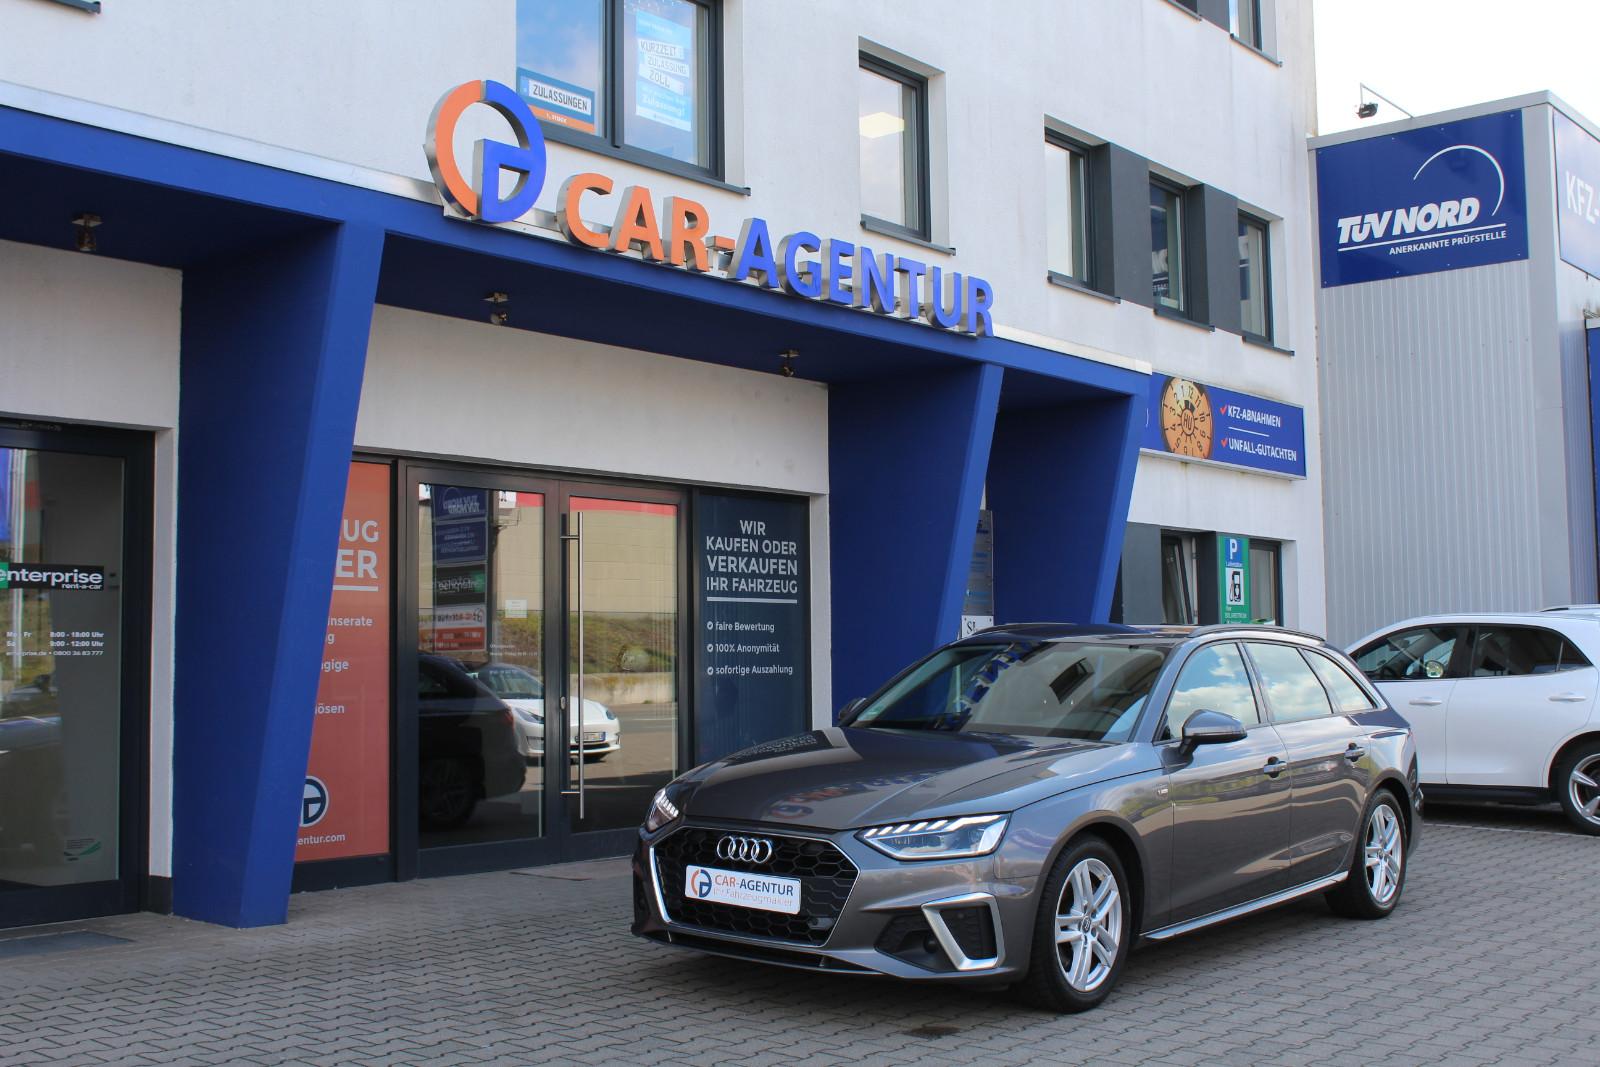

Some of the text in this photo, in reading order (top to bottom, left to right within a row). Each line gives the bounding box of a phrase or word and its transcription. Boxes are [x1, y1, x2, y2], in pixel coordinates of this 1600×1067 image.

[640, 41, 676, 56] KURZZEIT
[648, 56, 687, 74] ZULASSUNG
[649, 70, 671, 88] ZOLL
[532, 84, 588, 111] ZULASSUNGEN
[1565, 170, 1600, 225] KFZ-
[1392, 197, 1480, 235] NORD
[1388, 229, 1507, 256] ANERKANNTE PRÜFSTELLE
[557, 171, 994, 338] CAR-AGENTUR
[1227, 405, 1282, 428] KFZ-ABNAHMEN
[1228, 437, 1297, 462] UNFALL-GUTACHTEN
[343, 519, 379, 543] UG
[739, 519, 766, 536] WIR
[706, 536, 798, 556] KAUFEN ODER
[1229, 538, 1238, 560] P
[336, 548, 378, 580] ER
[706, 554, 798, 576] VERKAUFEN
[0, 568, 103, 587] enterprise
[61, 582, 103, 590] rent-a-car
[706, 576, 798, 594] IHR FAHRZEUG
[715, 621, 775, 634] faire Bewertung
[715, 642, 780, 655] 100% Anonymität
[321, 659, 350, 672] gige
[715, 664, 793, 676] sofortige Auszahlung
[296, 834, 346, 846] entur.com
[714, 874, 794, 896] CAR-AGENTUR
